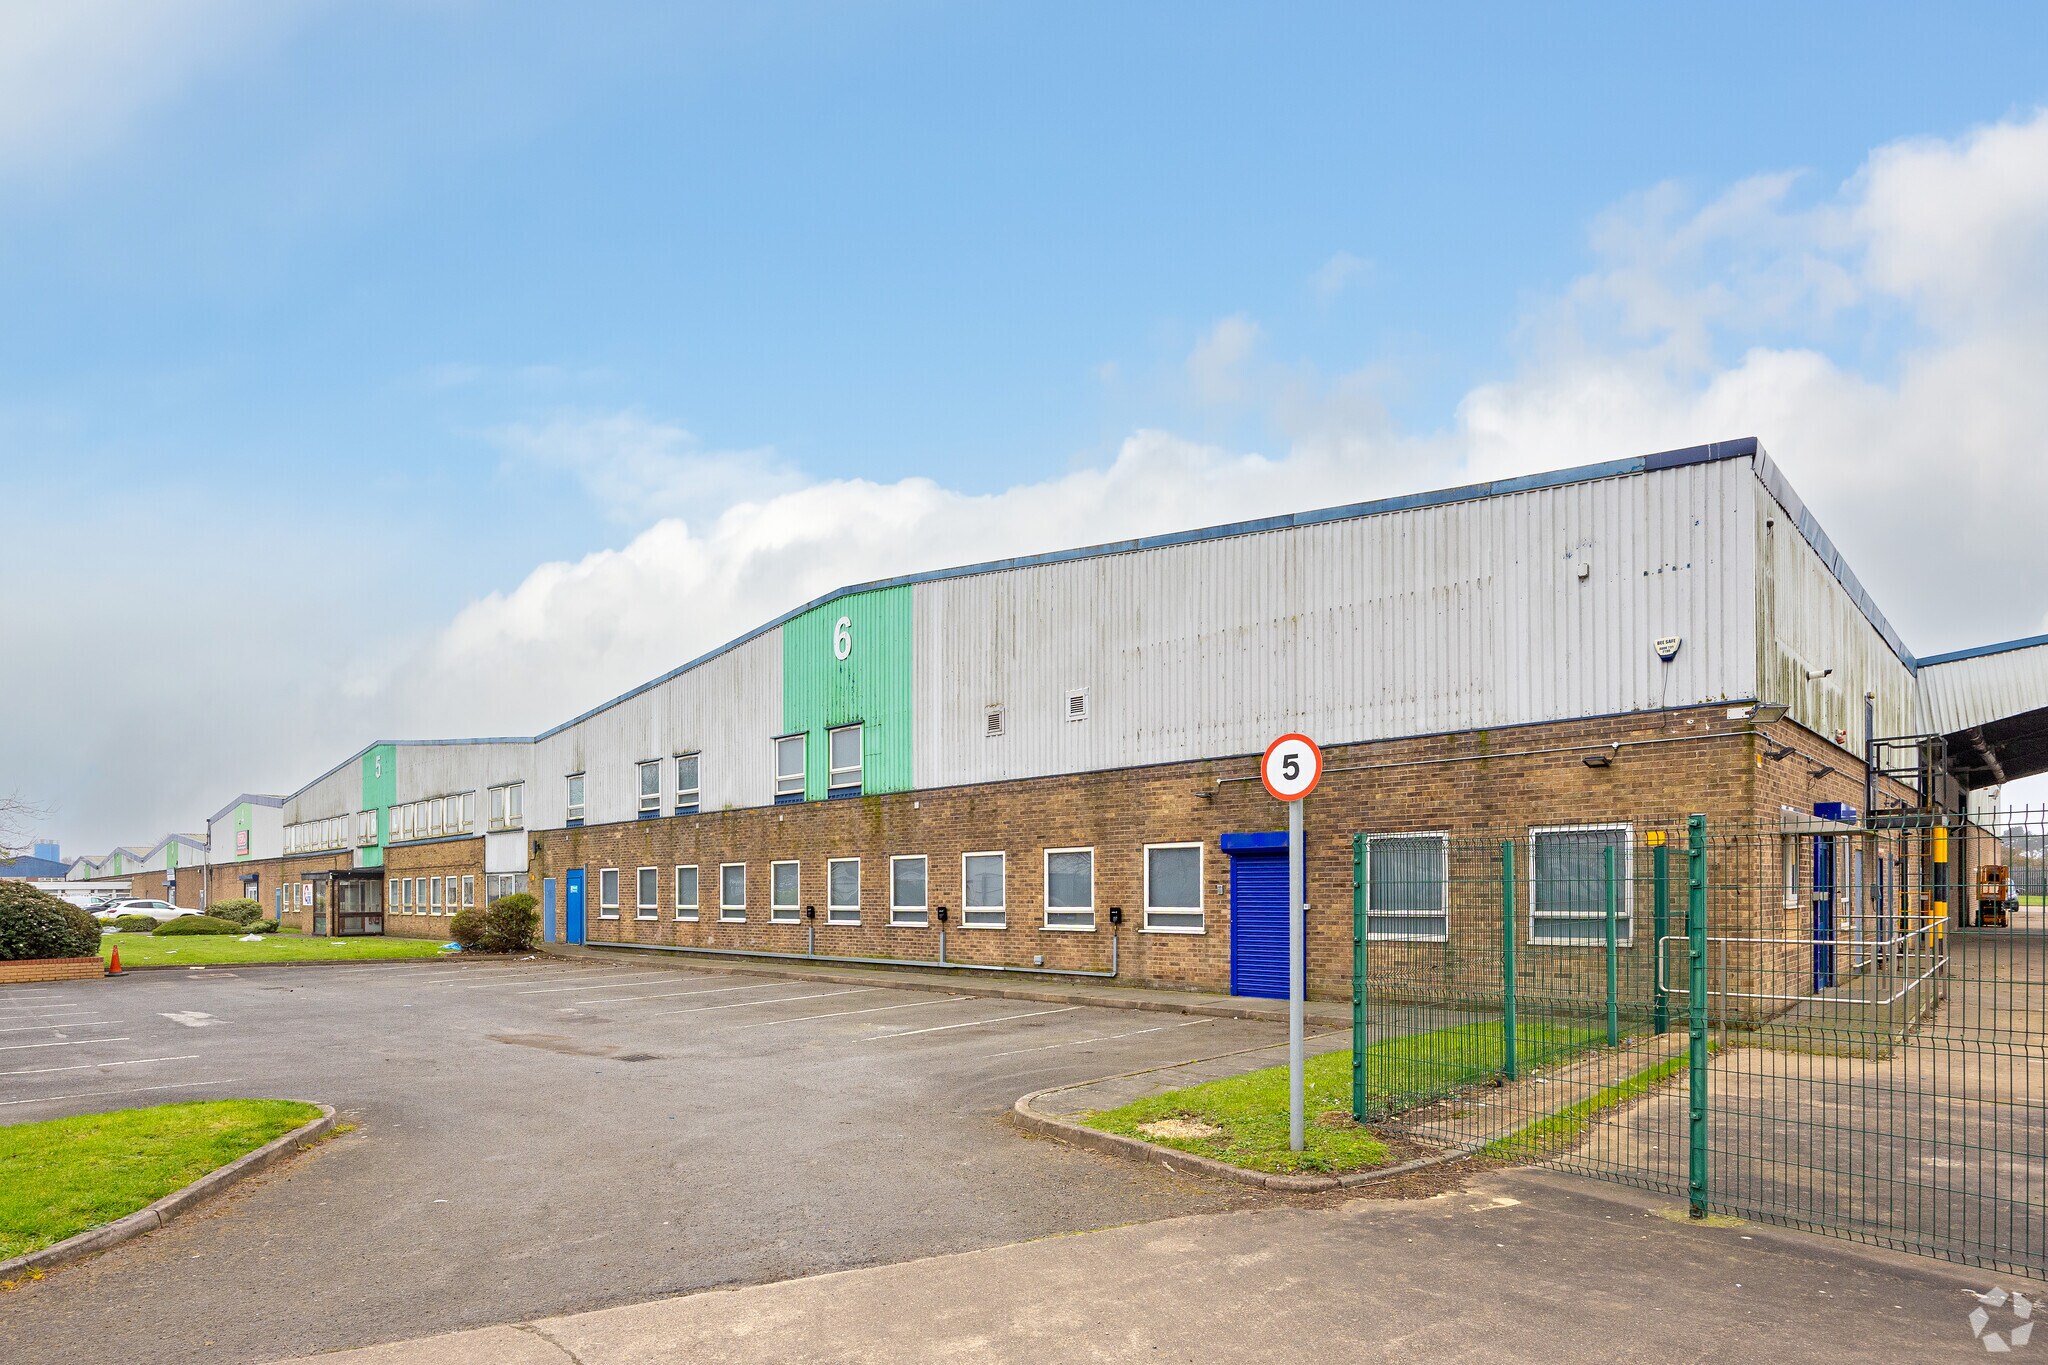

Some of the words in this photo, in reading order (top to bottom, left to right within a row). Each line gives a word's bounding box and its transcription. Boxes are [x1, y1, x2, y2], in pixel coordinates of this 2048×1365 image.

[833, 616, 852, 660] 6
[375, 755, 382, 779] 5
[1283, 754, 1300, 780] 5
